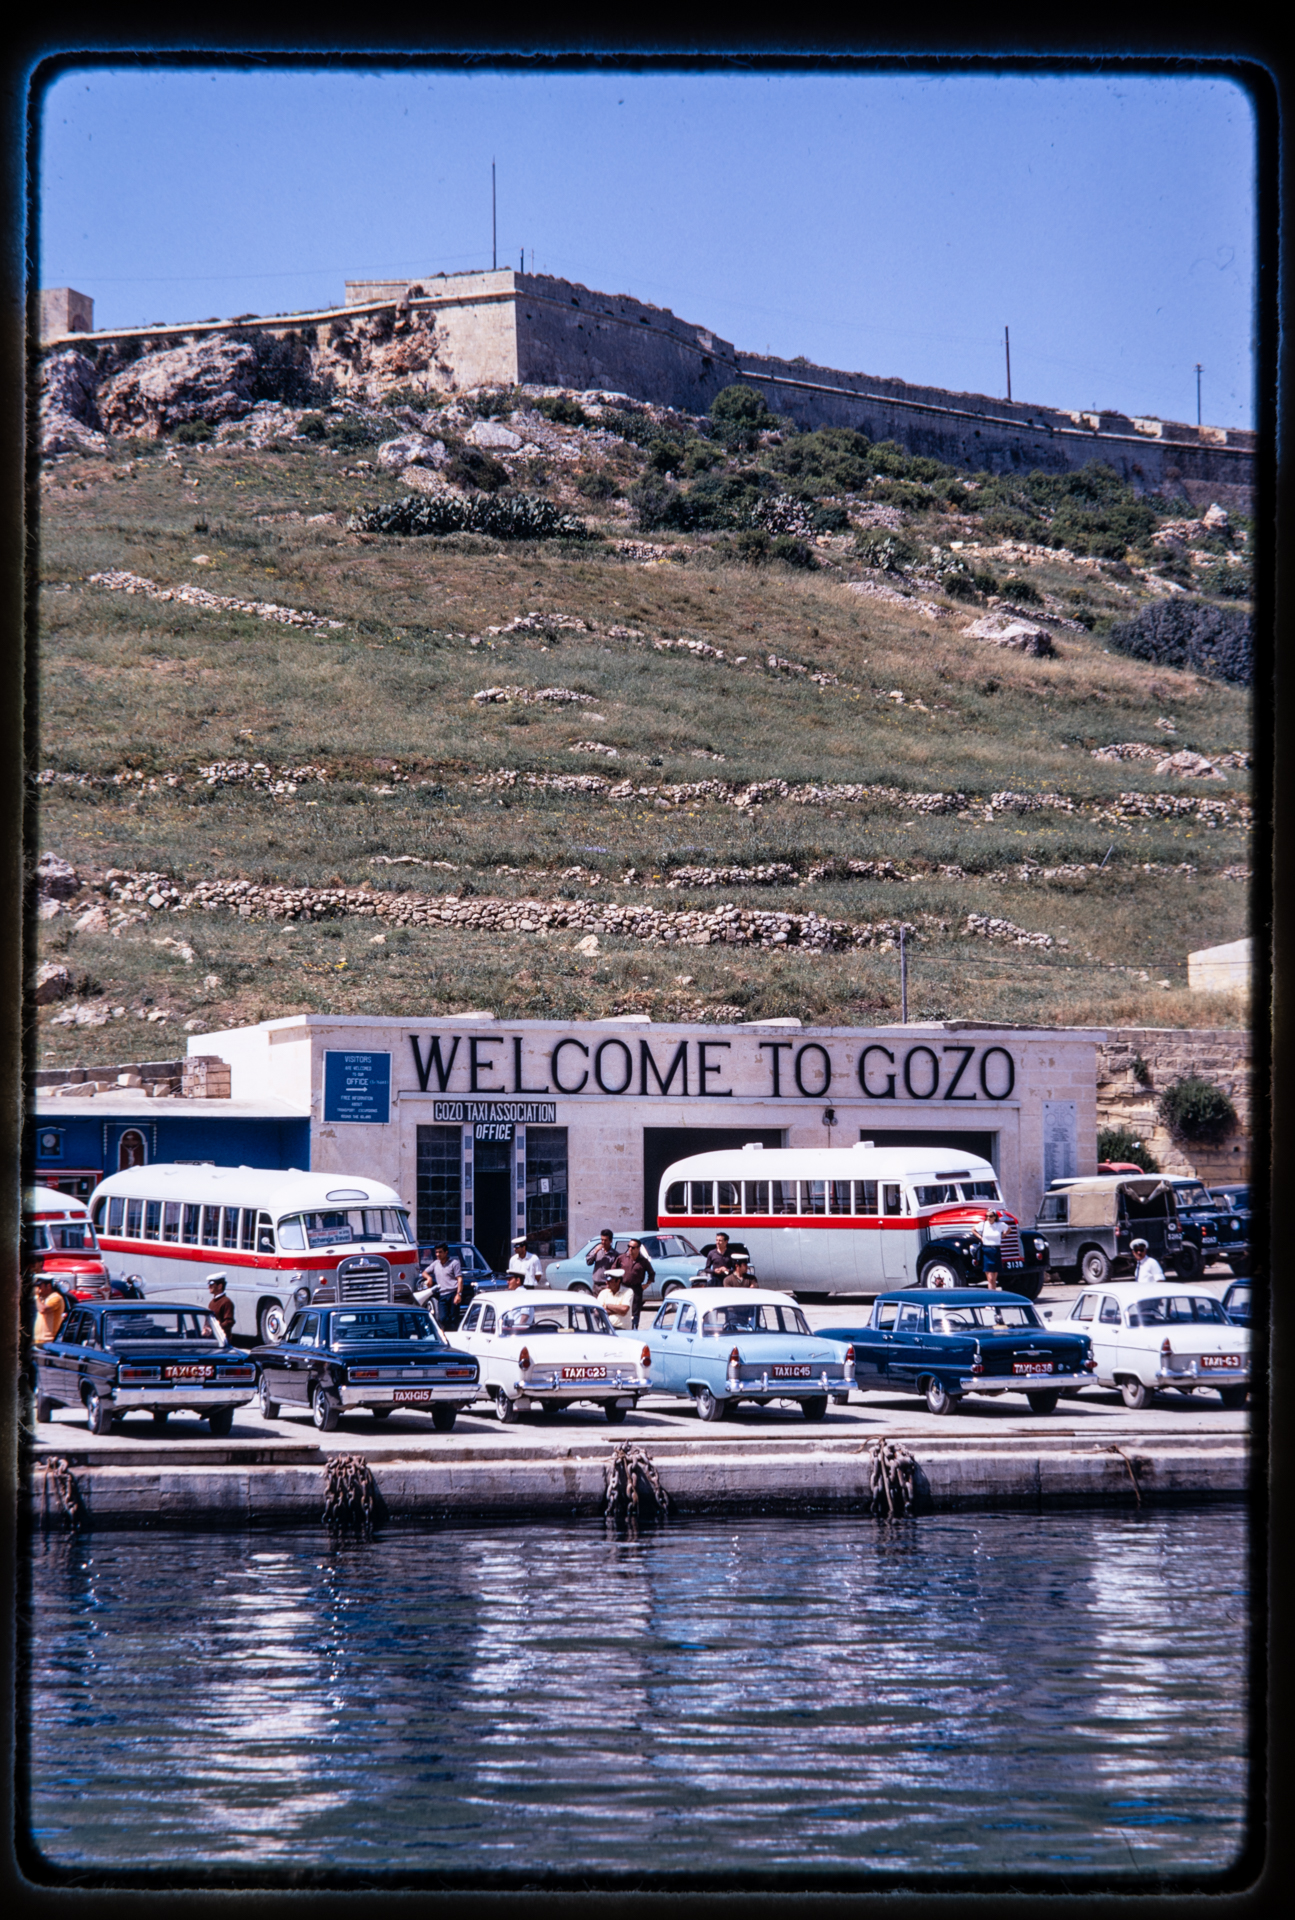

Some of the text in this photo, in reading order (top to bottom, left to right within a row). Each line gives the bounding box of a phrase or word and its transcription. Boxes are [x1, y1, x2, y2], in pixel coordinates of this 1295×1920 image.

[409, 1035, 1015, 1101] WELCOME TO GOZO
[435, 1102, 555, 1122] GOZO TAXI ASSOCIATION
[476, 1124, 512, 1140] OFFICE
